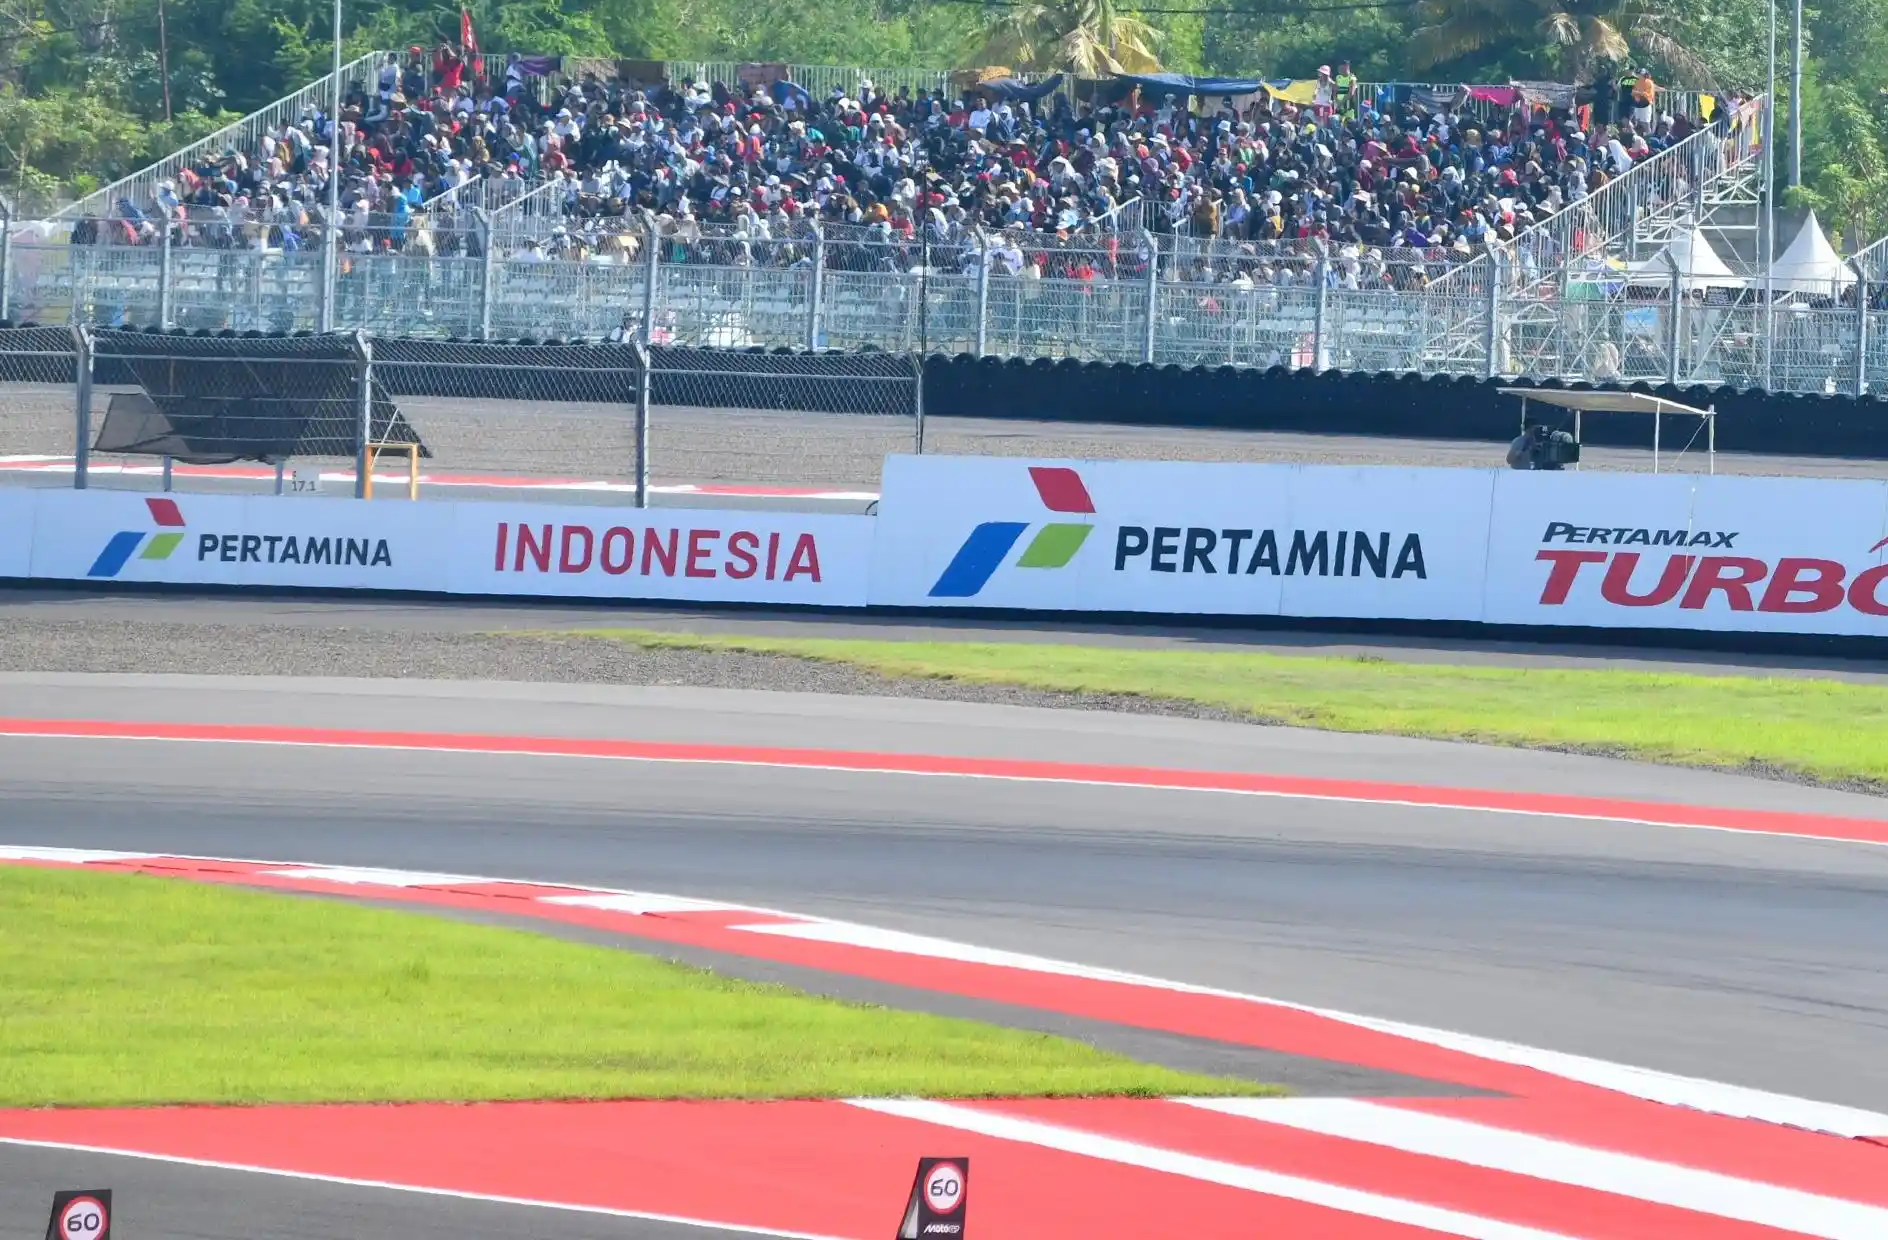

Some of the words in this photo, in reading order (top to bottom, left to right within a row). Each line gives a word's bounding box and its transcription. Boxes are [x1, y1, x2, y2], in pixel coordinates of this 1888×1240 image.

[199, 533, 392, 567] PERTAMINA
[1538, 522, 1740, 548] PERTAMAX
[495, 523, 822, 583] INDONESIA
[1114, 525, 1428, 580] PERTAMINA
[931, 1179, 958, 1196] 60
[67, 1213, 100, 1232] 60
